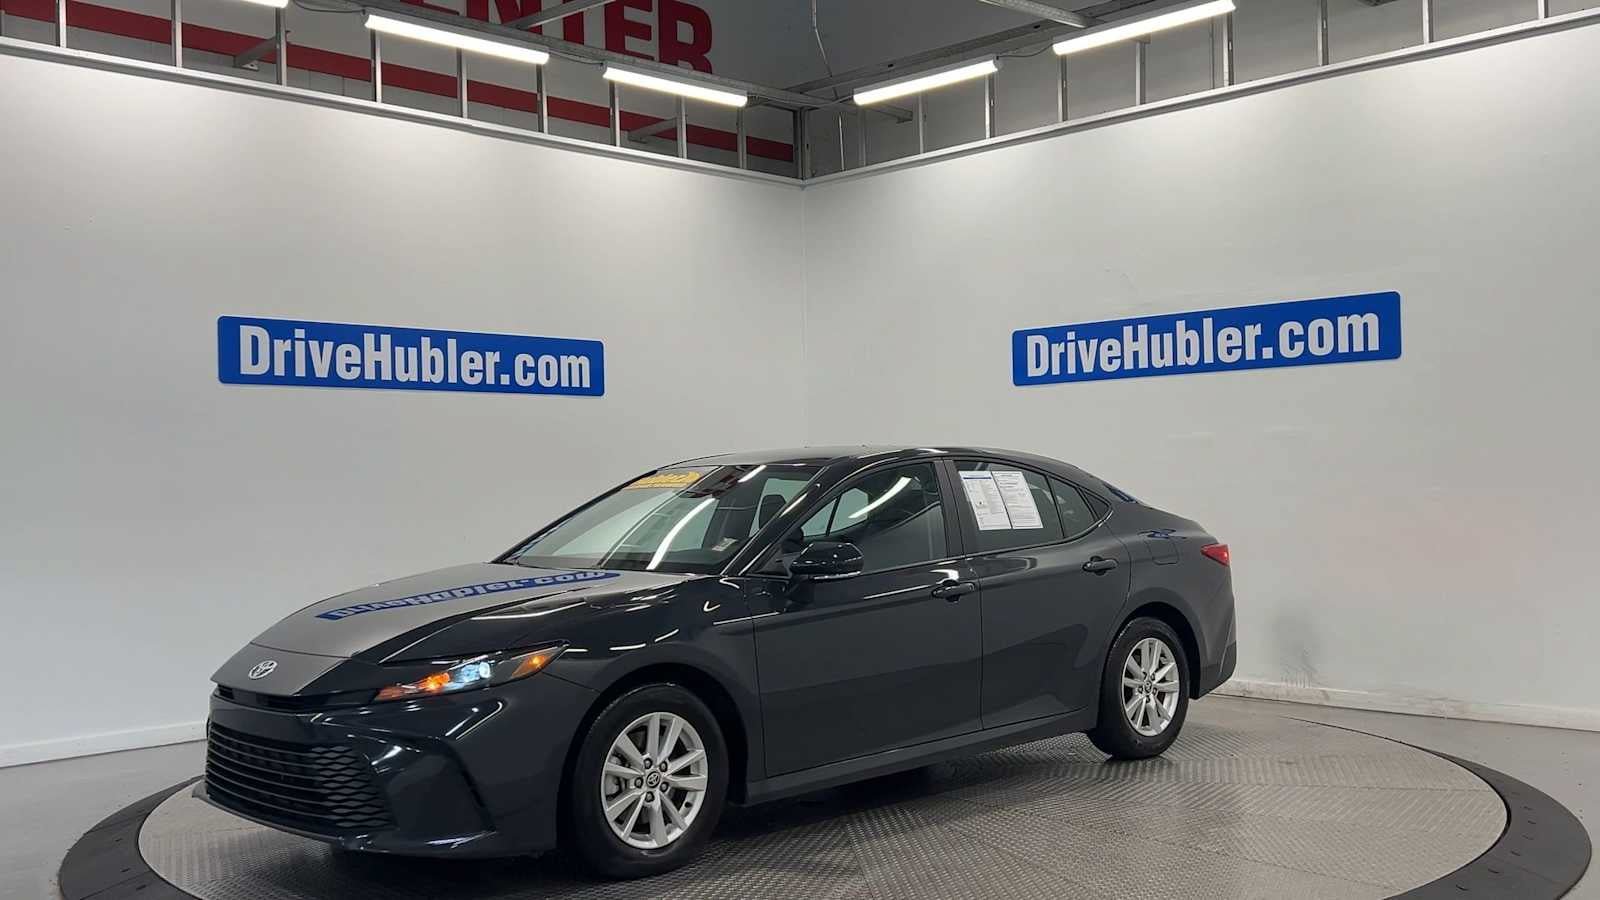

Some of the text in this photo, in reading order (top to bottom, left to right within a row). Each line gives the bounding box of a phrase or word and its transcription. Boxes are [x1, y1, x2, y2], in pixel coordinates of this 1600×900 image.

[400, 0, 712, 74] NER
[239, 325, 591, 388] DriveHubler.com
[1026, 312, 1380, 377] DriveHubler.com
